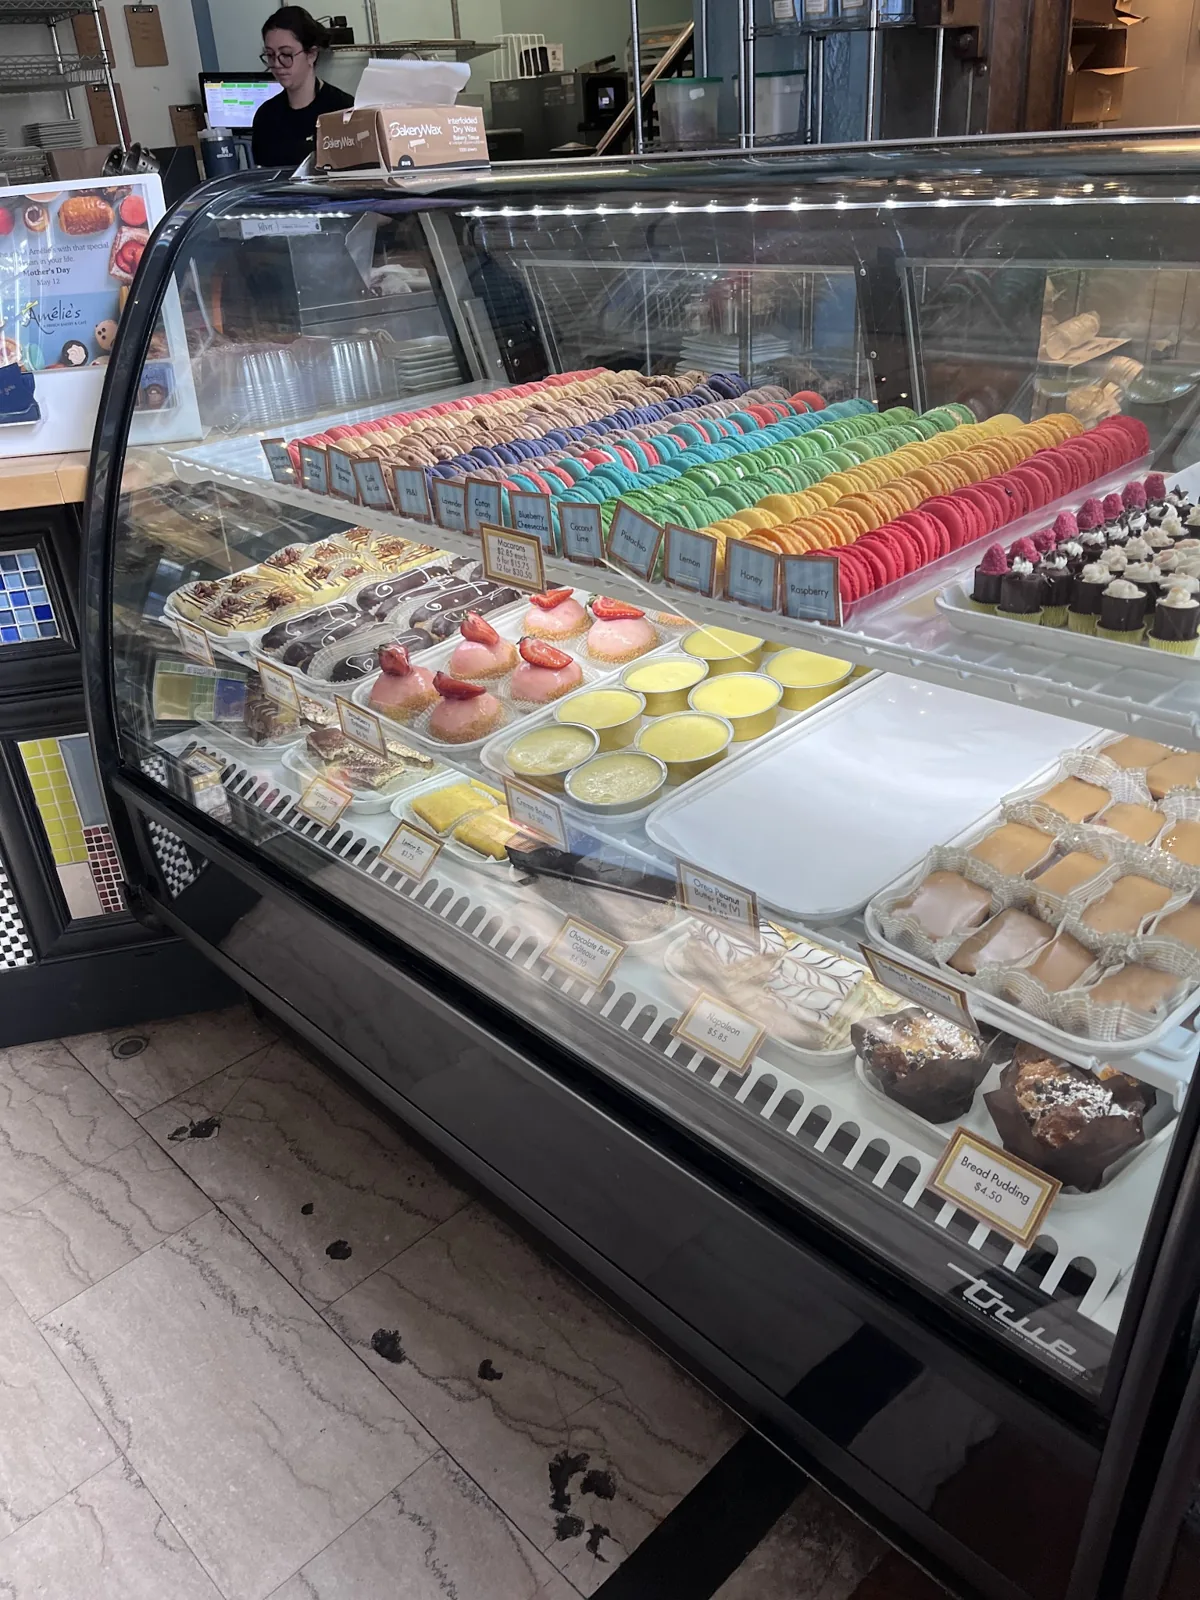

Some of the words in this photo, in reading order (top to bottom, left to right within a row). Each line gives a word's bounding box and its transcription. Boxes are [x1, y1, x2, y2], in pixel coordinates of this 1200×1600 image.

[448, 116, 478, 124] Interfolded
[389, 122, 443, 138] BakeryWax
[453, 126, 464, 134] Dry
[464, 125, 477, 133] Wax
[322, 135, 355, 150] BakeryWax
[57, 244, 72, 253] with
[72, 243, 86, 252] that
[86, 241, 110, 252] special
[23, 267, 56, 277] Mother's
[56, 266, 71, 275] Day
[36, 279, 51, 287] May
[22, 299, 81, 334] Amélie's
[441, 498, 462, 508] Lavender
[474, 498, 490, 508] Cotton
[446, 508, 461, 517] Lemon
[475, 508, 491, 521] Candy
[518, 510, 545, 521] Blueberry
[517, 521, 548, 532] Cheesecake
[570, 522, 593, 532] Coconut
[498, 537, 526, 553] Macarons
[576, 533, 590, 544] Lime
[620, 529, 647, 553] Pistachio
[501, 556, 510, 565] for
[514, 553, 527, 562] each
[678, 552, 701, 569] Lemon
[503, 564, 512, 574] for
[740, 568, 763, 587] Honey
[790, 584, 830, 599] Raspberry
[401, 838, 416, 851] Lemon
[415, 846, 425, 856] Bar
[693, 878, 714, 894] Oreo
[714, 887, 740, 906] Peanut
[694, 887, 715, 903] Butter
[716, 897, 728, 909] Pie
[729, 902, 741, 917] (V)
[569, 929, 597, 951] Chocolate
[597, 945, 611, 957] Petit
[571, 942, 597, 961] Gâteaux
[909, 977, 952, 1002] Caramel
[706, 1012, 741, 1037] Napoleon
[707, 1027, 729, 1044] $5.85
[960, 1155, 991, 1181] Bread
[991, 1172, 1031, 1206] Pudding
[974, 1182, 1003, 1204] $4.50
